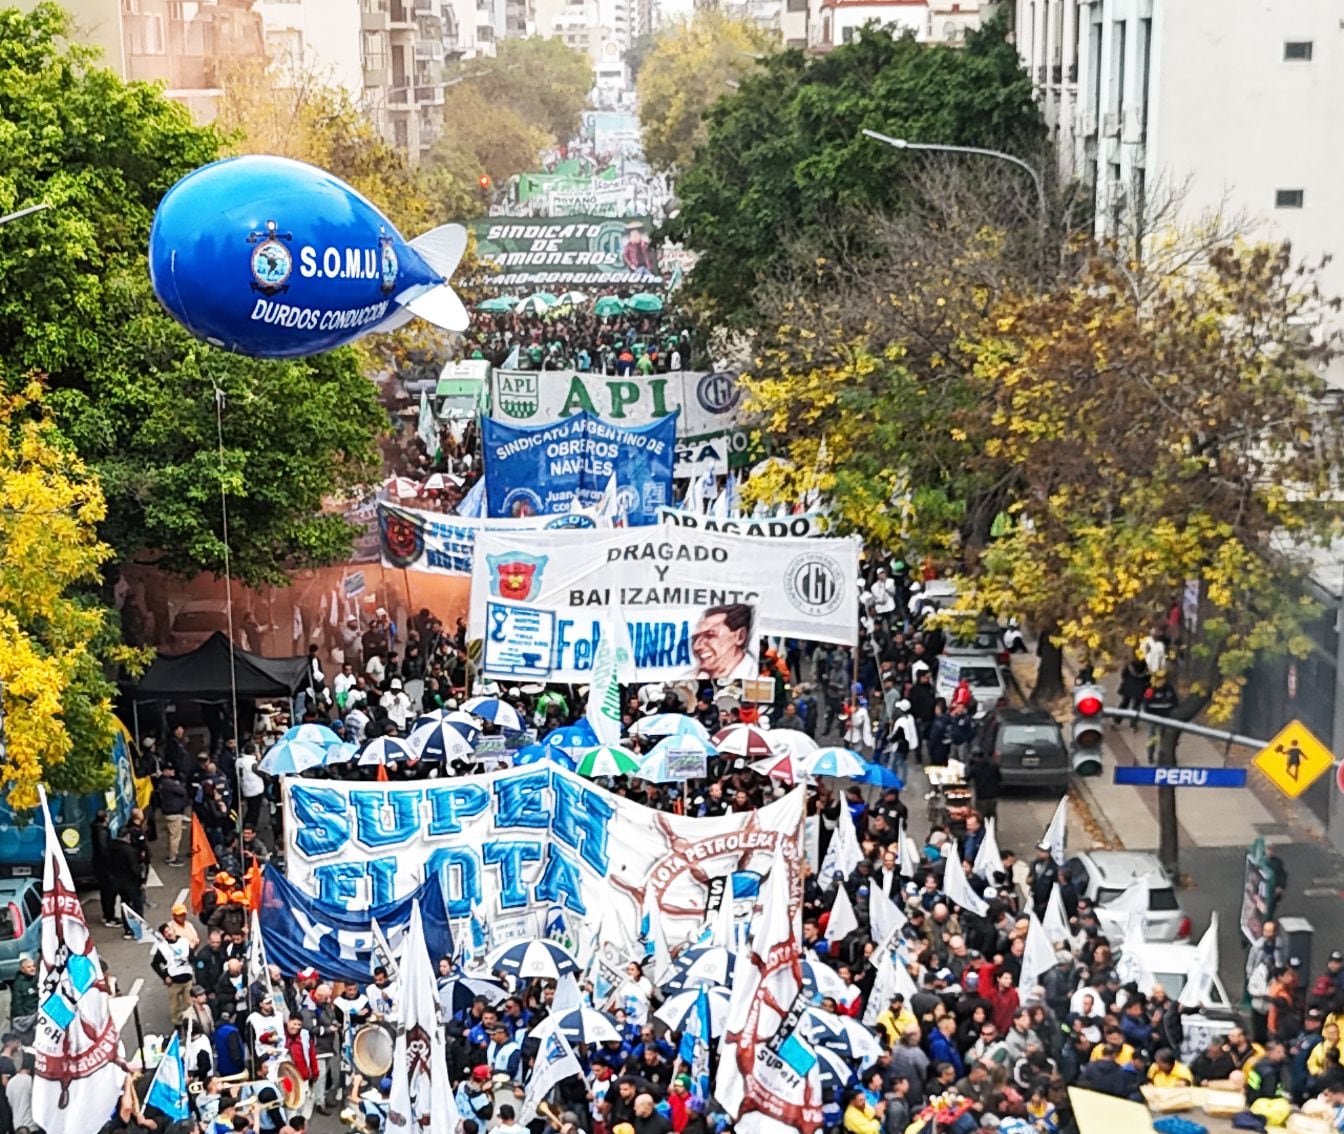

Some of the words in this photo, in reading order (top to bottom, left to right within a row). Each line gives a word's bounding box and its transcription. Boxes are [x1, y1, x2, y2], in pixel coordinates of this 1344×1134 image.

[487, 224, 601, 239] SINDICATO
[530, 239, 563, 252] DE
[299, 246, 380, 280] S.O.M.U.
[250, 299, 321, 329] DURDOS
[502, 378, 536, 394] APL
[496, 426, 569, 460] SINDICATO
[570, 419, 647, 449] ARGENTINO
[647, 440, 666, 456] DE
[546, 439, 619, 459] OBREROS
[662, 511, 810, 538] DRAGADO
[607, 542, 729, 563] DRAGADO
[654, 564, 670, 582] Y
[1154, 768, 1207, 785] PERU
[684, 832, 776, 864] PETROLERA
